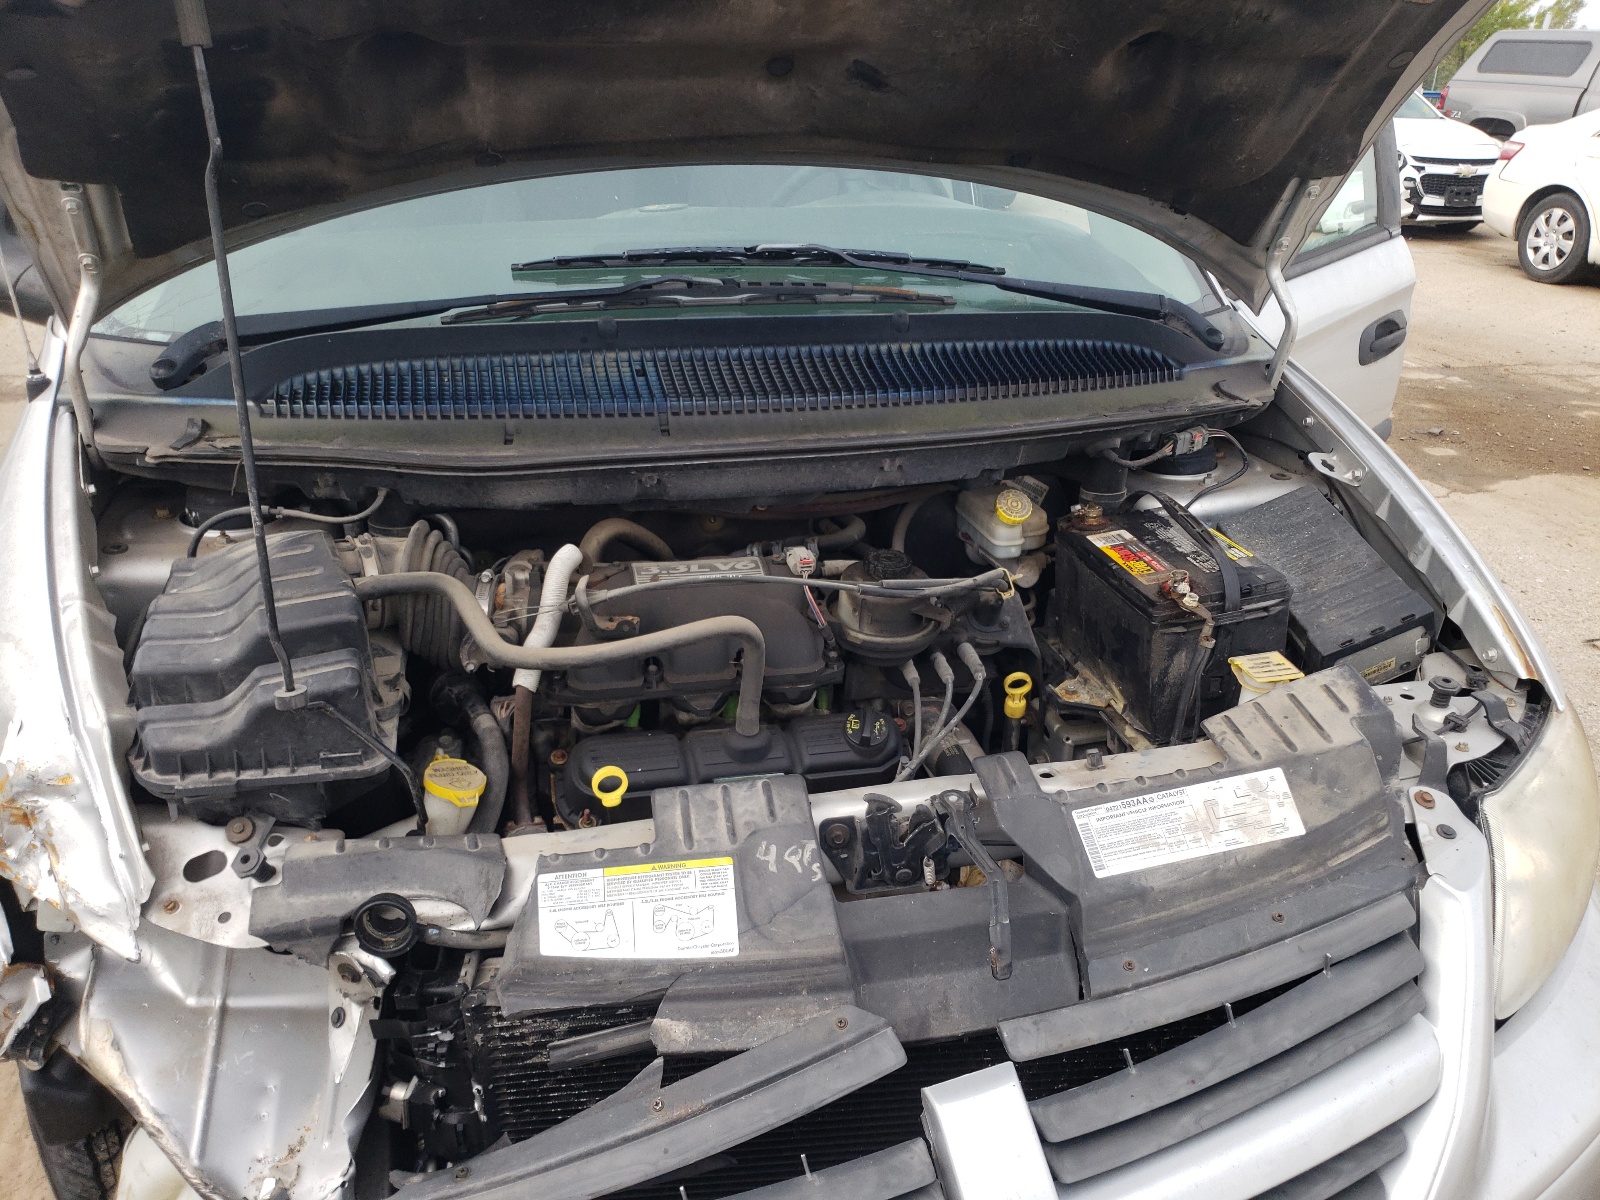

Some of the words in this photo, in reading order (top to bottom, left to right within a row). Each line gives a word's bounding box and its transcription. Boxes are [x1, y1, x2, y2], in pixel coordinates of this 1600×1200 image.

[640, 563, 711, 575] 3.3L
[713, 561, 756, 571] V6
[432, 765, 471, 773] WASHER
[1156, 789, 1186, 800] CATALYST
[1096, 811, 1126, 823] IMPORTANT
[1148, 799, 1185, 811] INFORMATION
[657, 863, 687, 871] WARNING
[554, 872, 588, 881] ATTENTION
